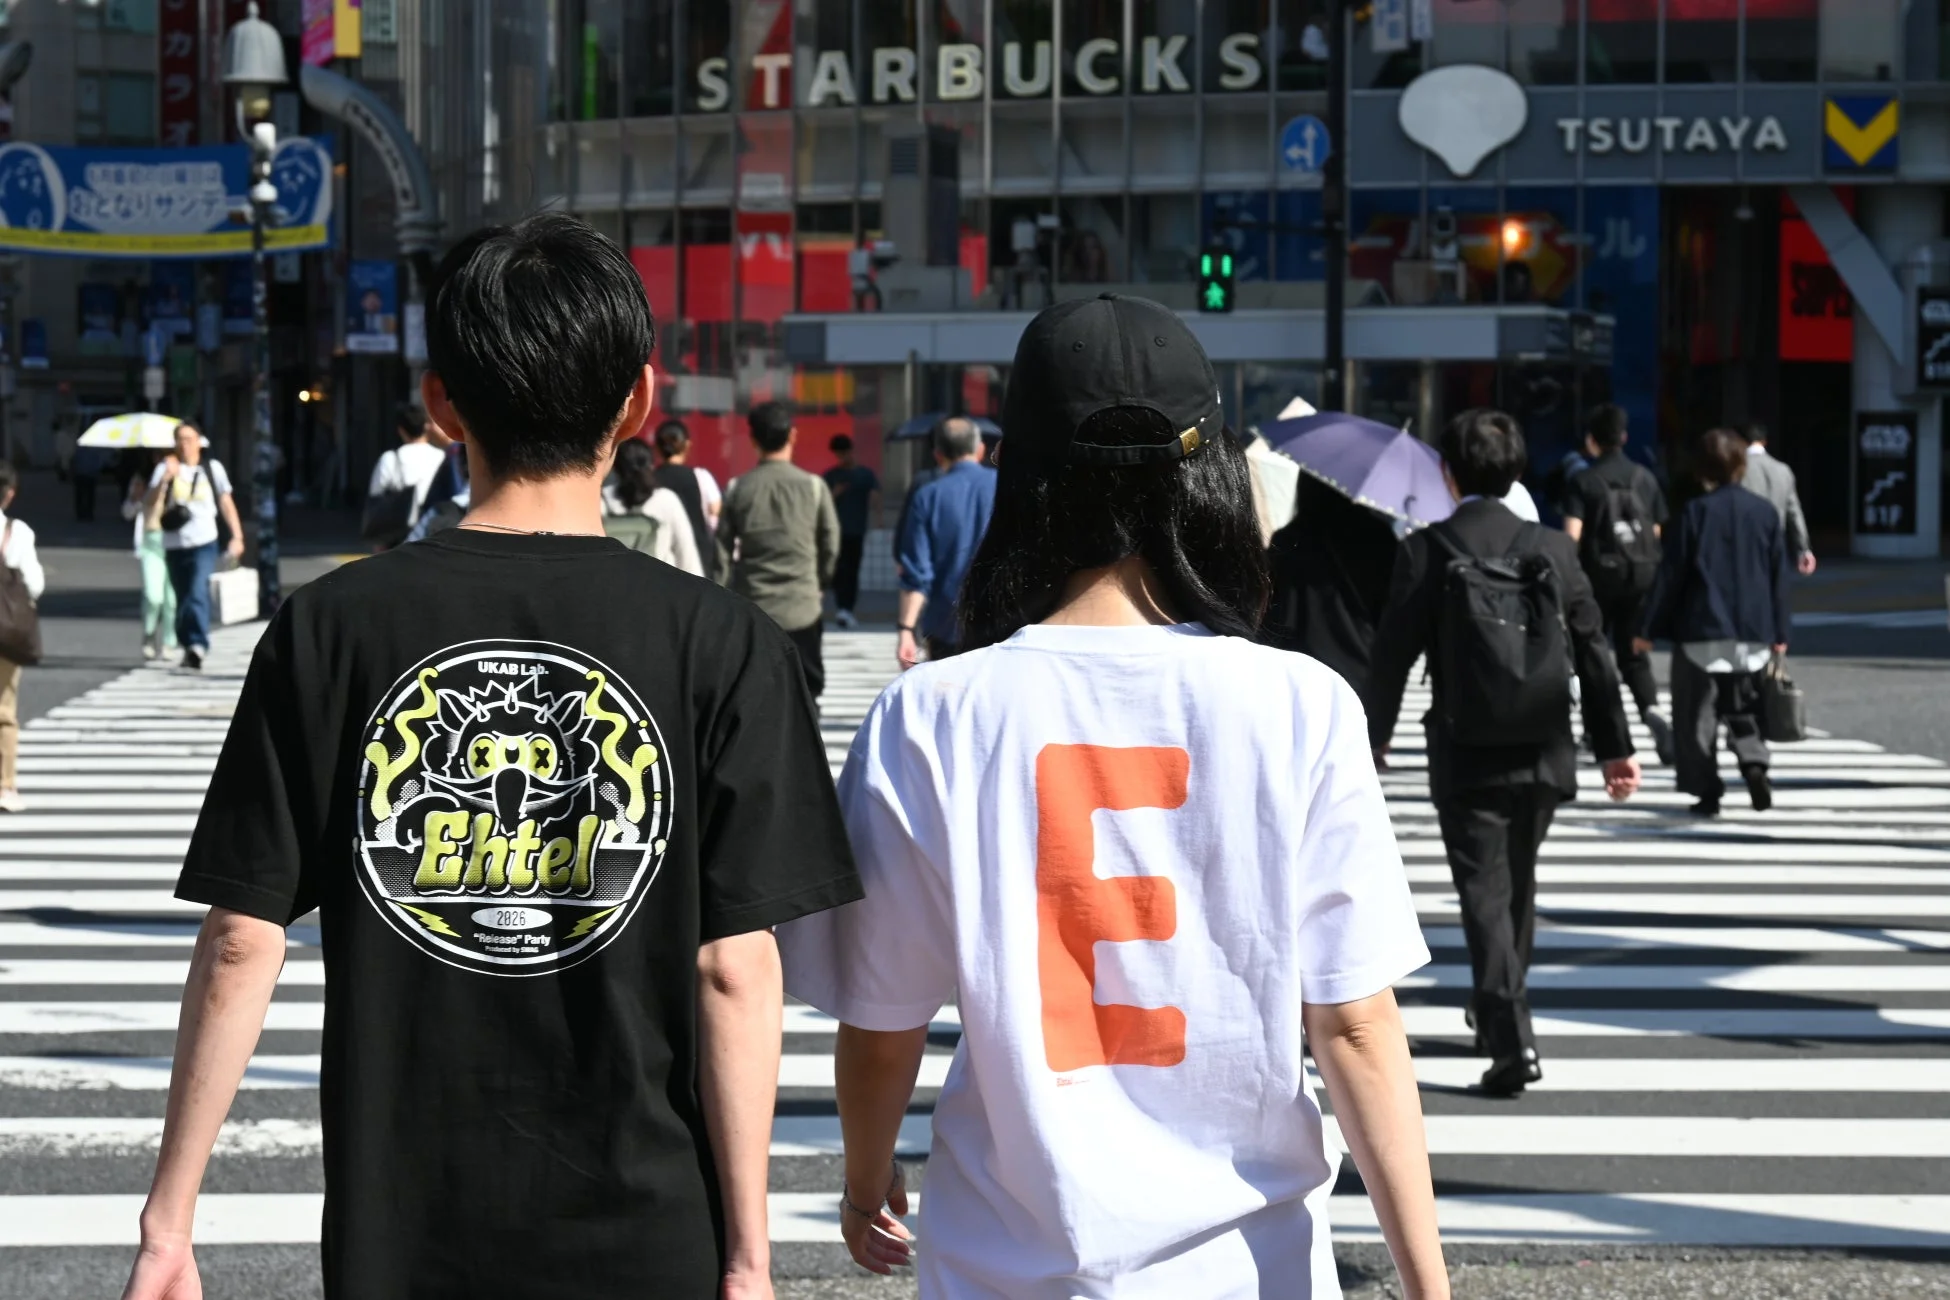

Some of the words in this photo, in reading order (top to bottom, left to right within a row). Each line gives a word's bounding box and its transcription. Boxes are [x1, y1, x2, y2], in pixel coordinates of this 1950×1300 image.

[697, 33, 1262, 111] STARBUCKS
[1556, 115, 1789, 153] TSUTAYA
[477, 661, 519, 676] UKAB
[520, 662, 550, 676] Lab.
[413, 810, 604, 896] Ehtel
[496, 910, 527, 927] 2026
[1035, 743, 1190, 1072] E
[523, 934, 552, 947] Party
